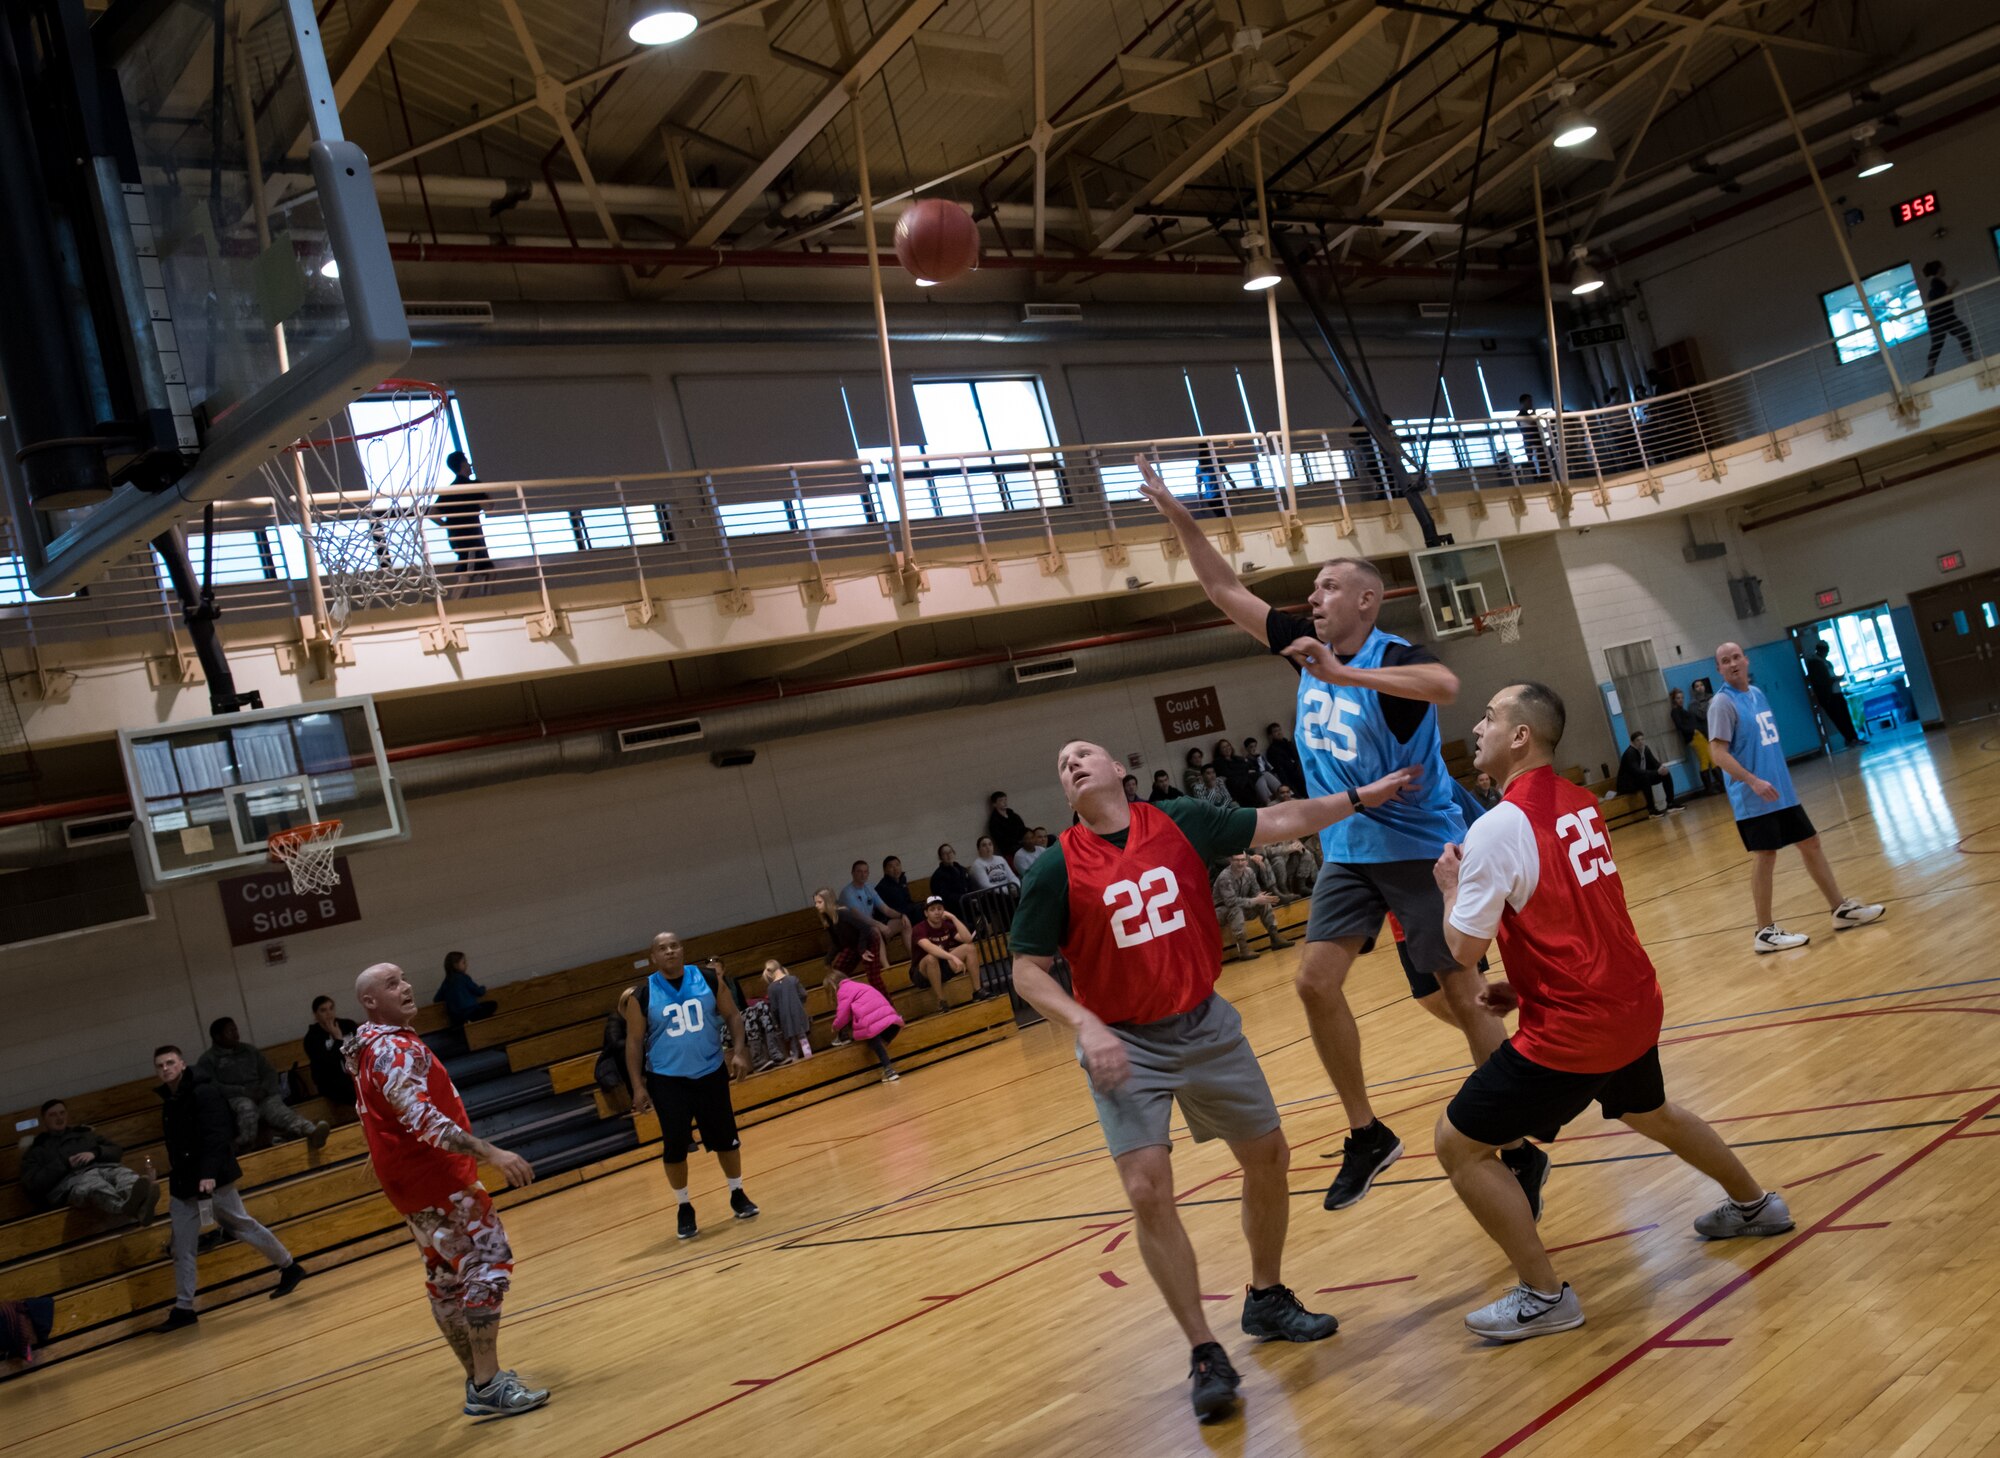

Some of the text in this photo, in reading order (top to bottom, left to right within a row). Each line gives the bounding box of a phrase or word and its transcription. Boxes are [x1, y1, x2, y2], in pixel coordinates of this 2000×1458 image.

[1165, 693, 1210, 714] Court 1
[1172, 714, 1214, 735] Side A
[1303, 688, 1361, 762] 25
[1755, 710, 1780, 747] 15
[1555, 806, 1617, 887] 25
[241, 877, 298, 903] Cou
[1102, 866, 1187, 949] 22
[252, 899, 337, 933] Side B
[662, 997, 705, 1038] 30
